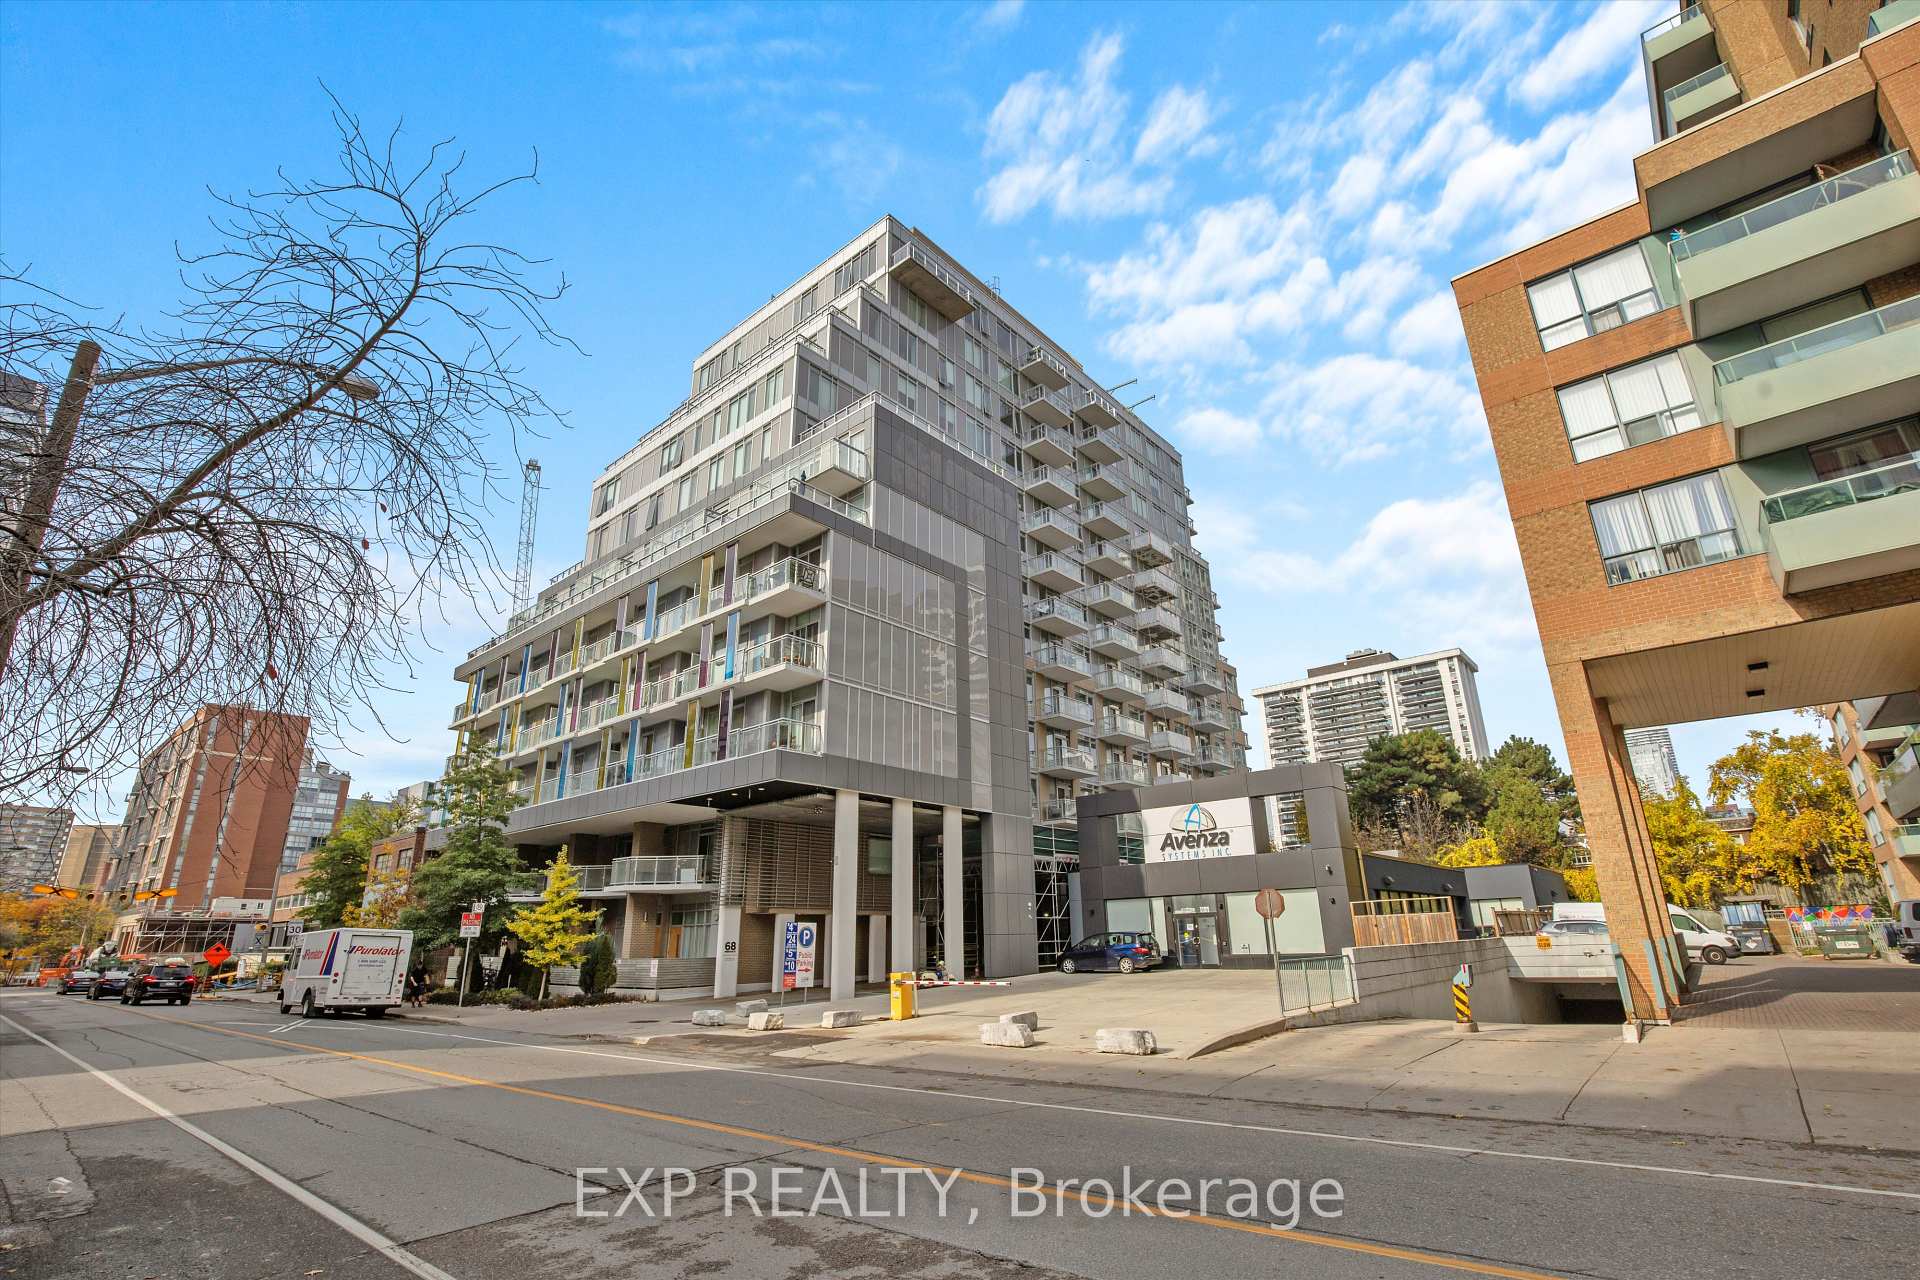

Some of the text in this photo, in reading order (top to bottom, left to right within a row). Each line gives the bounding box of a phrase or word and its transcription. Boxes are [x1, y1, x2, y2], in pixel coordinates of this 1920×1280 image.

[1160, 831, 1230, 852] Avenza
[1162, 850, 1207, 861] SYSTEMS
[289, 926, 302, 934] 30
[354, 945, 405, 956] Purolator
[725, 942, 736, 950] 68
